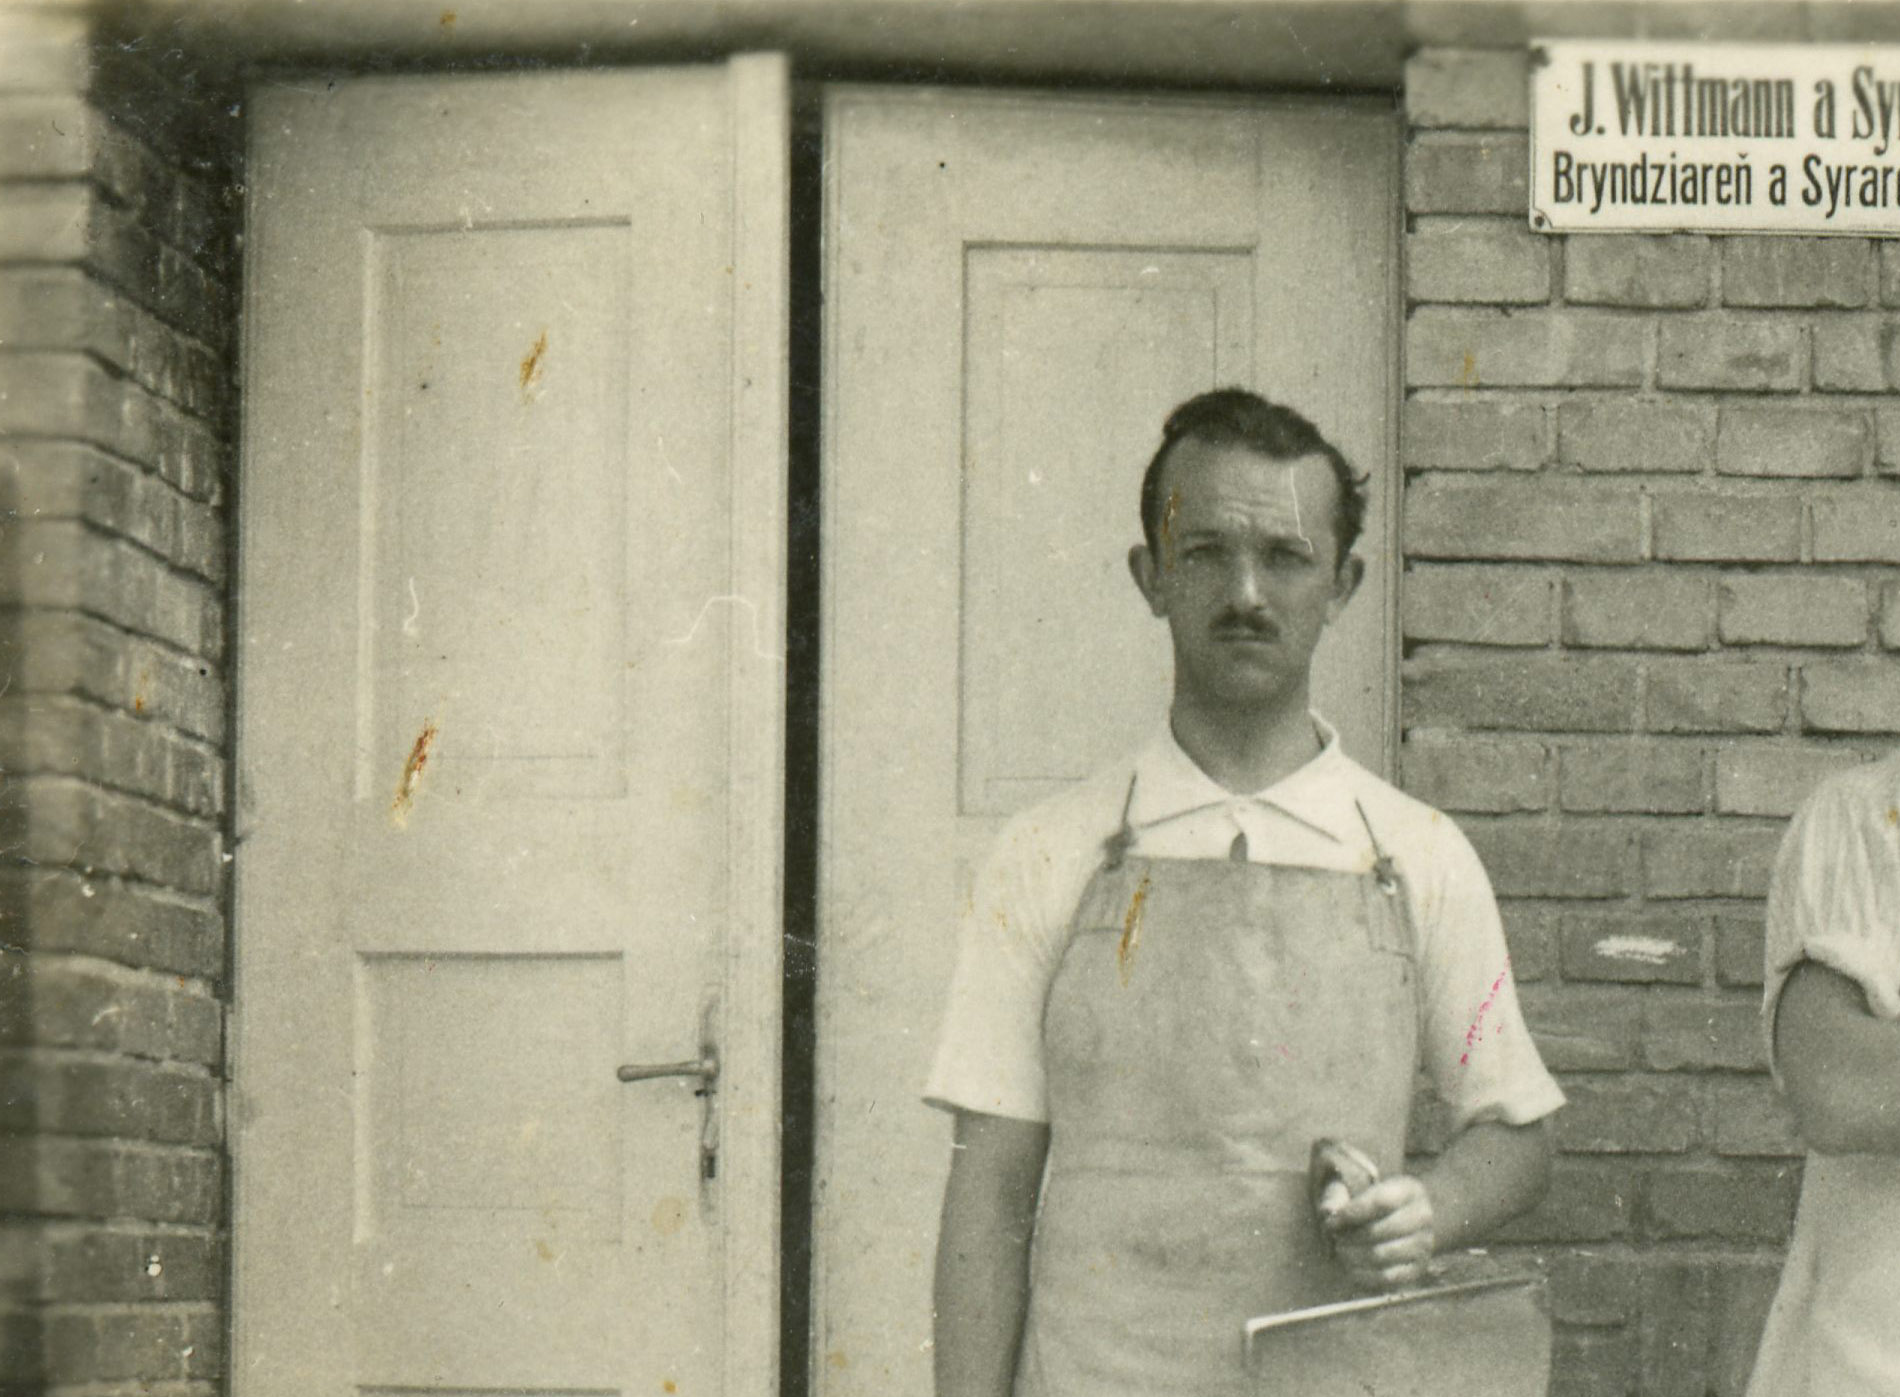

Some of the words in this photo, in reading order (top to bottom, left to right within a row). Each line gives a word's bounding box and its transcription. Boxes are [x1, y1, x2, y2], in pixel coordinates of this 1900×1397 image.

[1569, 61, 1606, 136] J.
[1609, 61, 1795, 138] Wittmann
[1813, 79, 1837, 139] a
[1552, 150, 1752, 214] Bryndziareň
[1768, 163, 1787, 206] a
